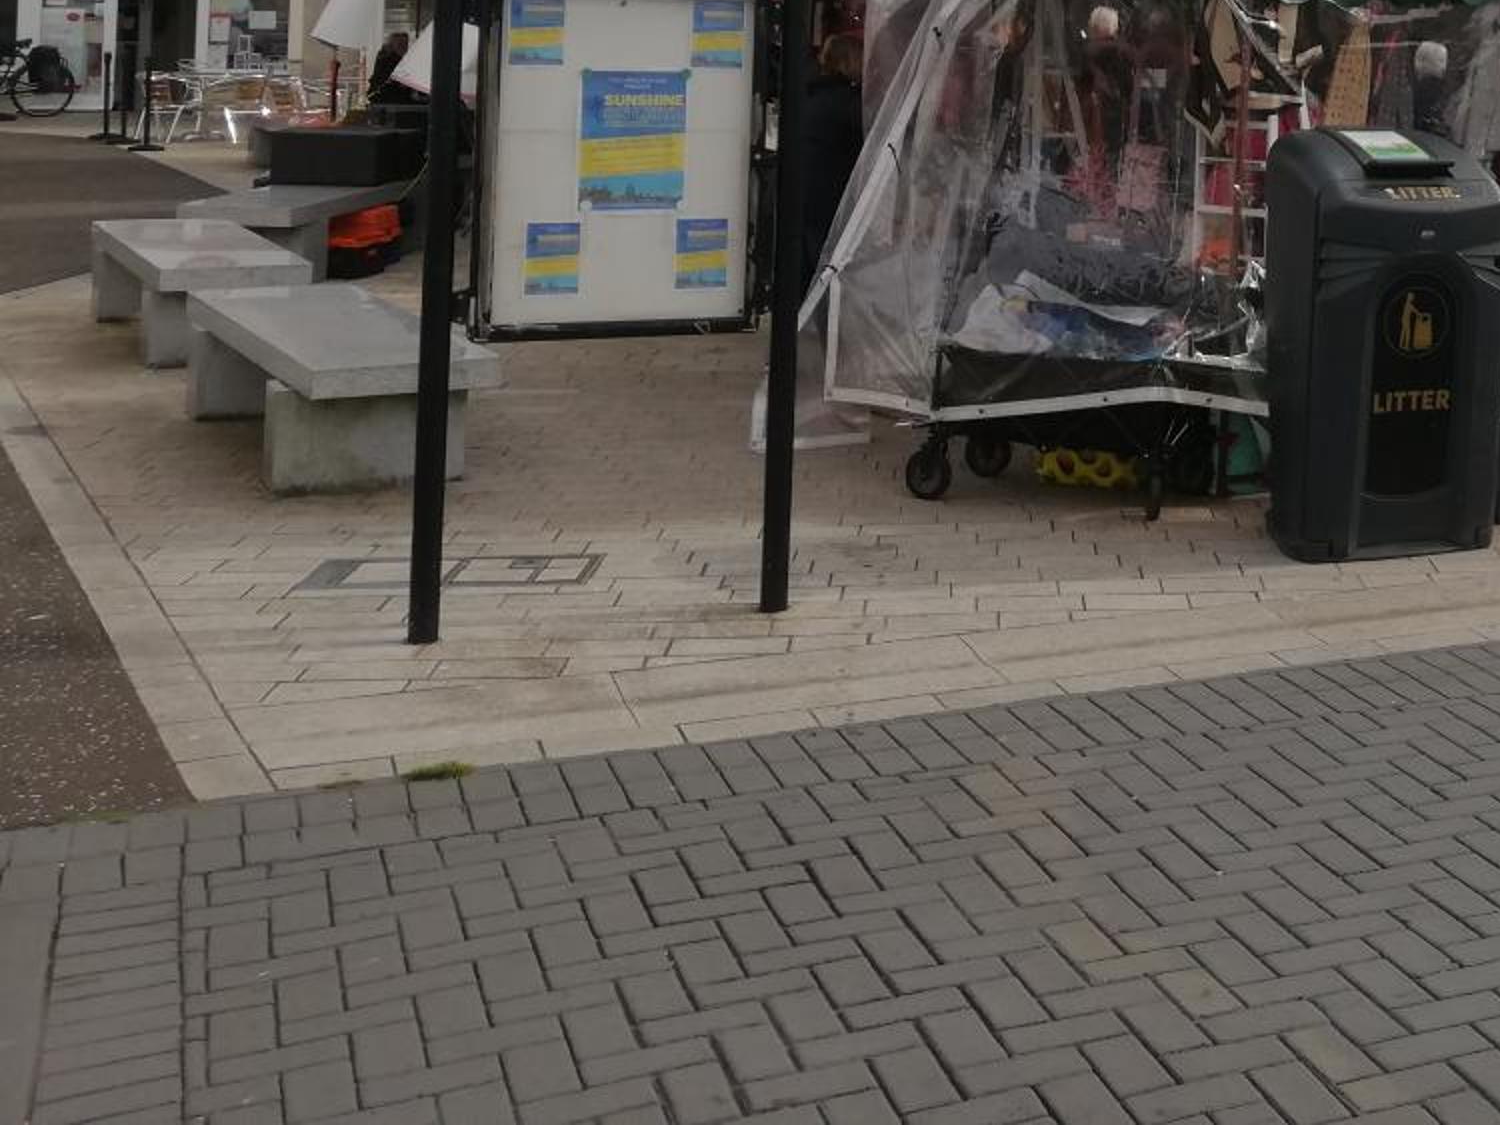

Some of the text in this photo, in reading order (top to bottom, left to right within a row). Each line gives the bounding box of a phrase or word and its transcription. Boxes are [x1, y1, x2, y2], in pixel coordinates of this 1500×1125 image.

[604, 94, 685, 107] SUNSHINE
[1384, 186, 1461, 200] LITTER
[1374, 389, 1450, 414] LITTER
